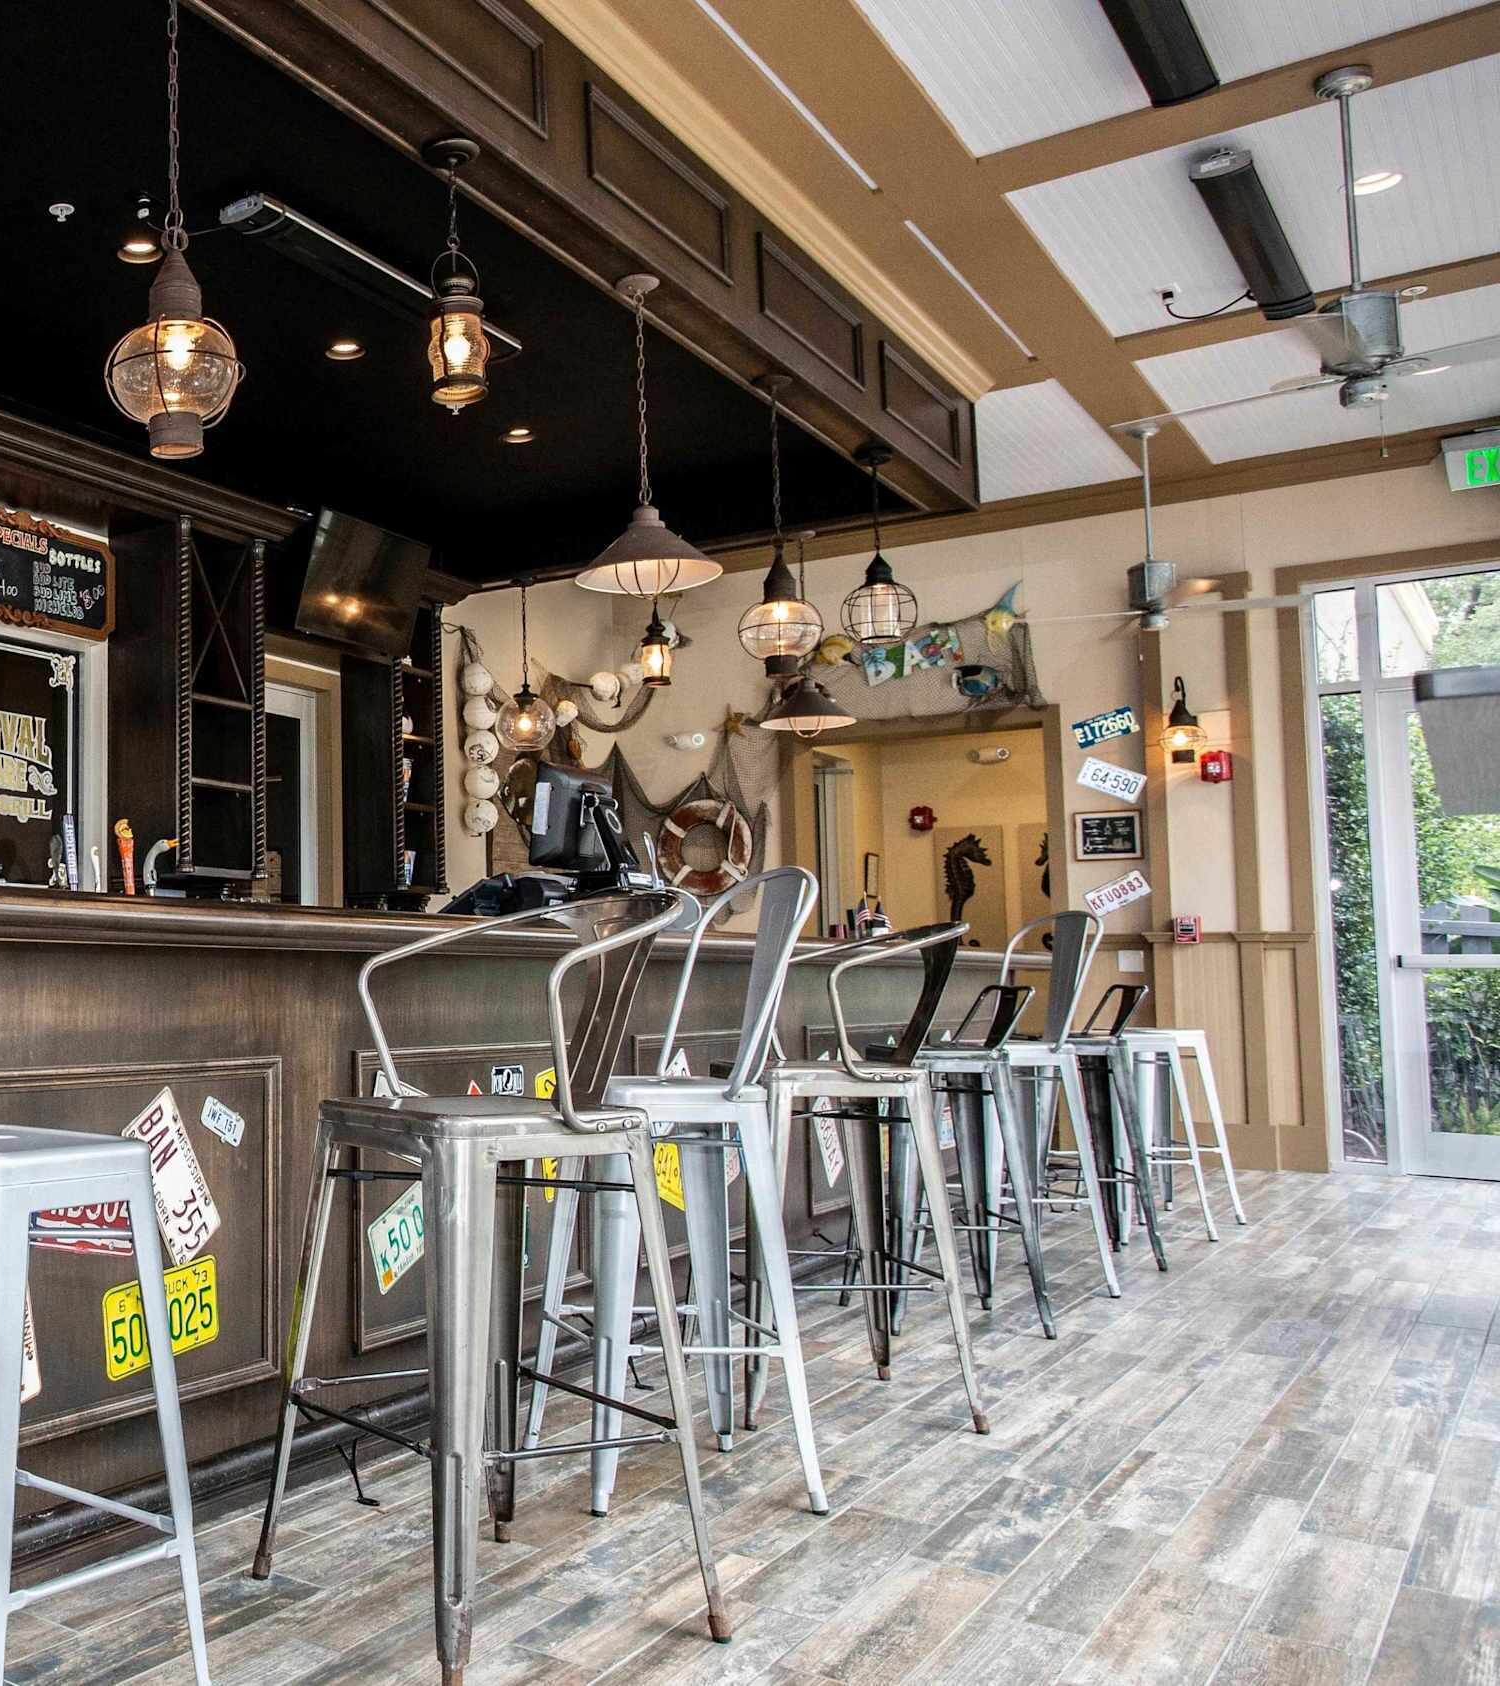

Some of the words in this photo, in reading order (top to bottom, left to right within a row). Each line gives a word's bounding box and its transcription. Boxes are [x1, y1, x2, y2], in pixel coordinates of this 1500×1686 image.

[49, 548, 101, 574] BOTTLES
[138, 1104, 178, 1173] BAN
[175, 1128, 206, 1197] MISSISSIPPI
[172, 1188, 210, 1250] 355
